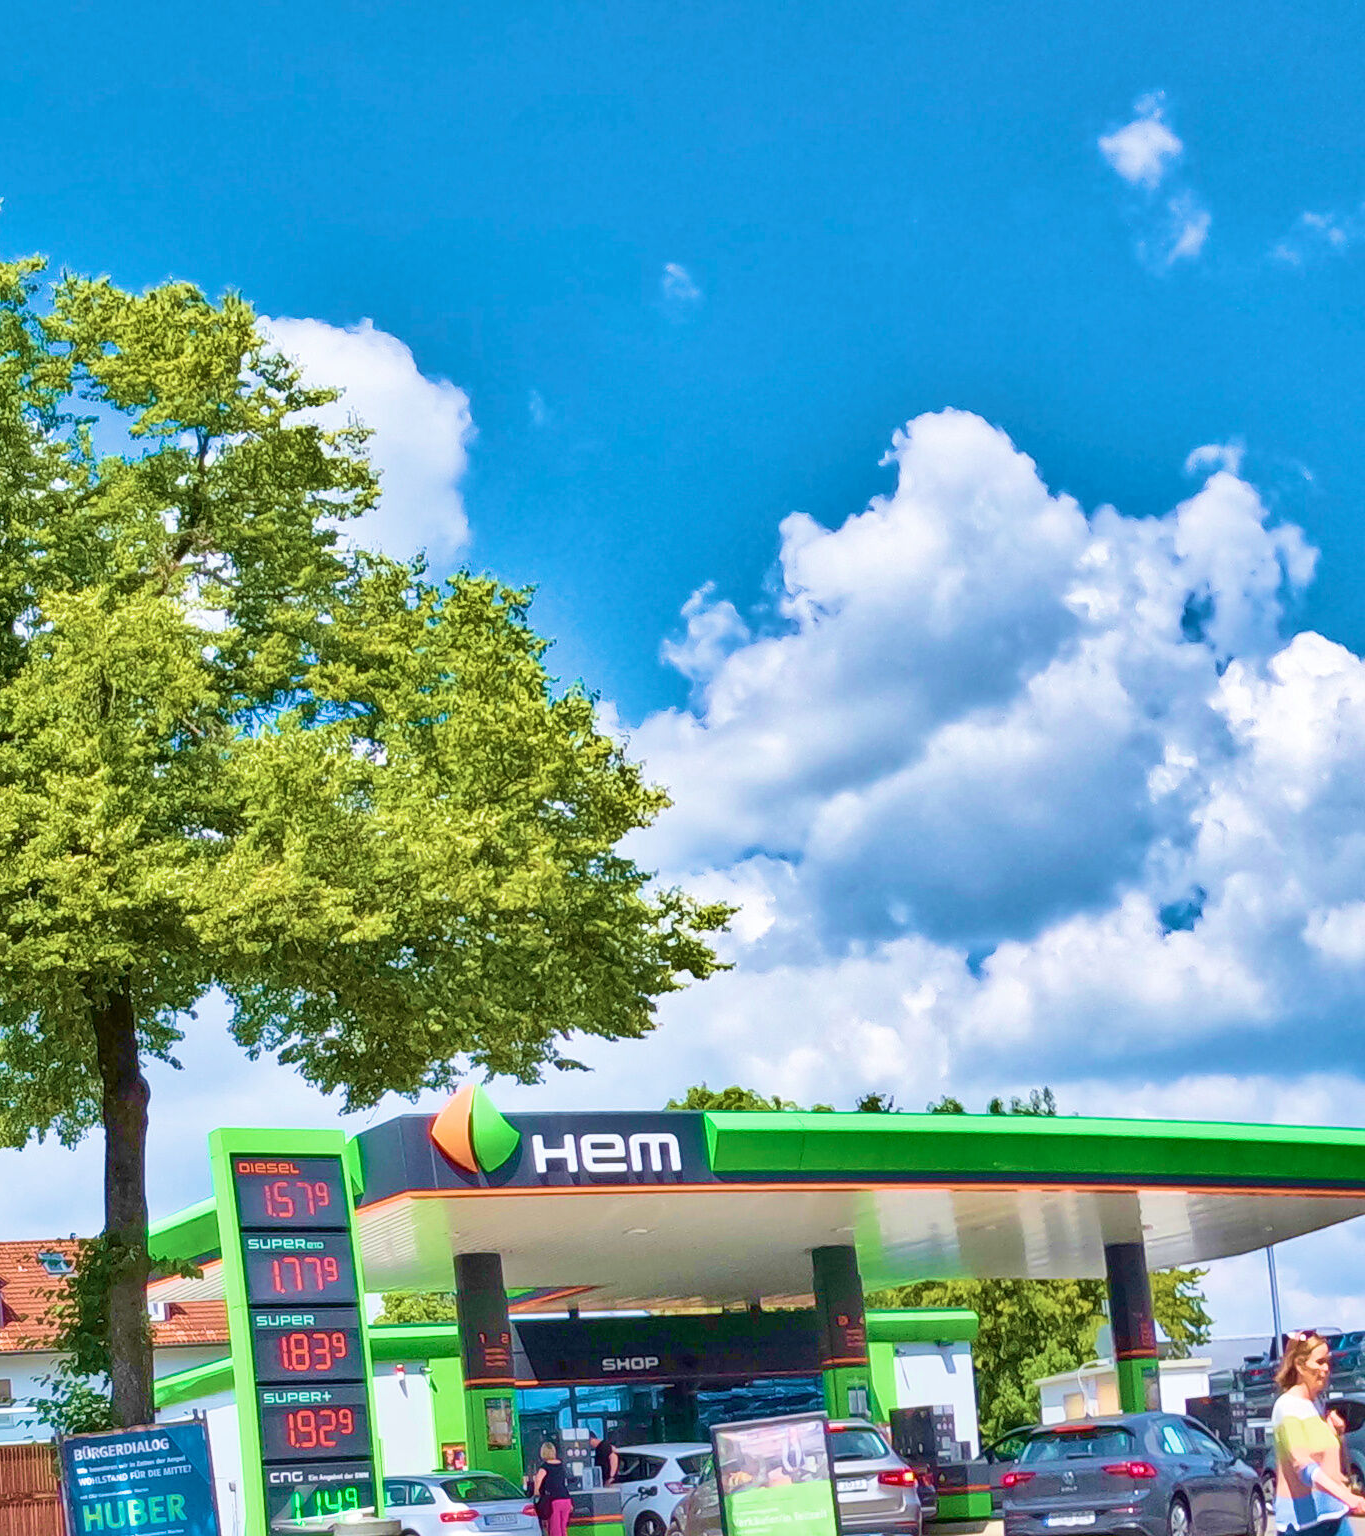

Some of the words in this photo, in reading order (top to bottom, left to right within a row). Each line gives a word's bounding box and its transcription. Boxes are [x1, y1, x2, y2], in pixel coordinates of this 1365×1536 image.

[238, 1162, 300, 1174] DIESEL
[264, 1181, 330, 1218] 1.579
[272, 1256, 338, 1294] 1.779
[256, 1315, 314, 1326] SUPER
[281, 1331, 346, 1371] 1.839
[602, 1356, 659, 1372] SHOP
[263, 1391, 332, 1404] SUPER+
[288, 1408, 354, 1448] 1.929
[73, 1438, 169, 1461] BÜRGERDIALOG
[78, 1472, 128, 1486] WOHLSTAND
[130, 1469, 145, 1480] FÜR
[148, 1468, 161, 1478] DIE
[163, 1465, 192, 1476] MITTE?
[270, 1471, 303, 1483] CNG
[82, 1494, 188, 1532] HUBER
